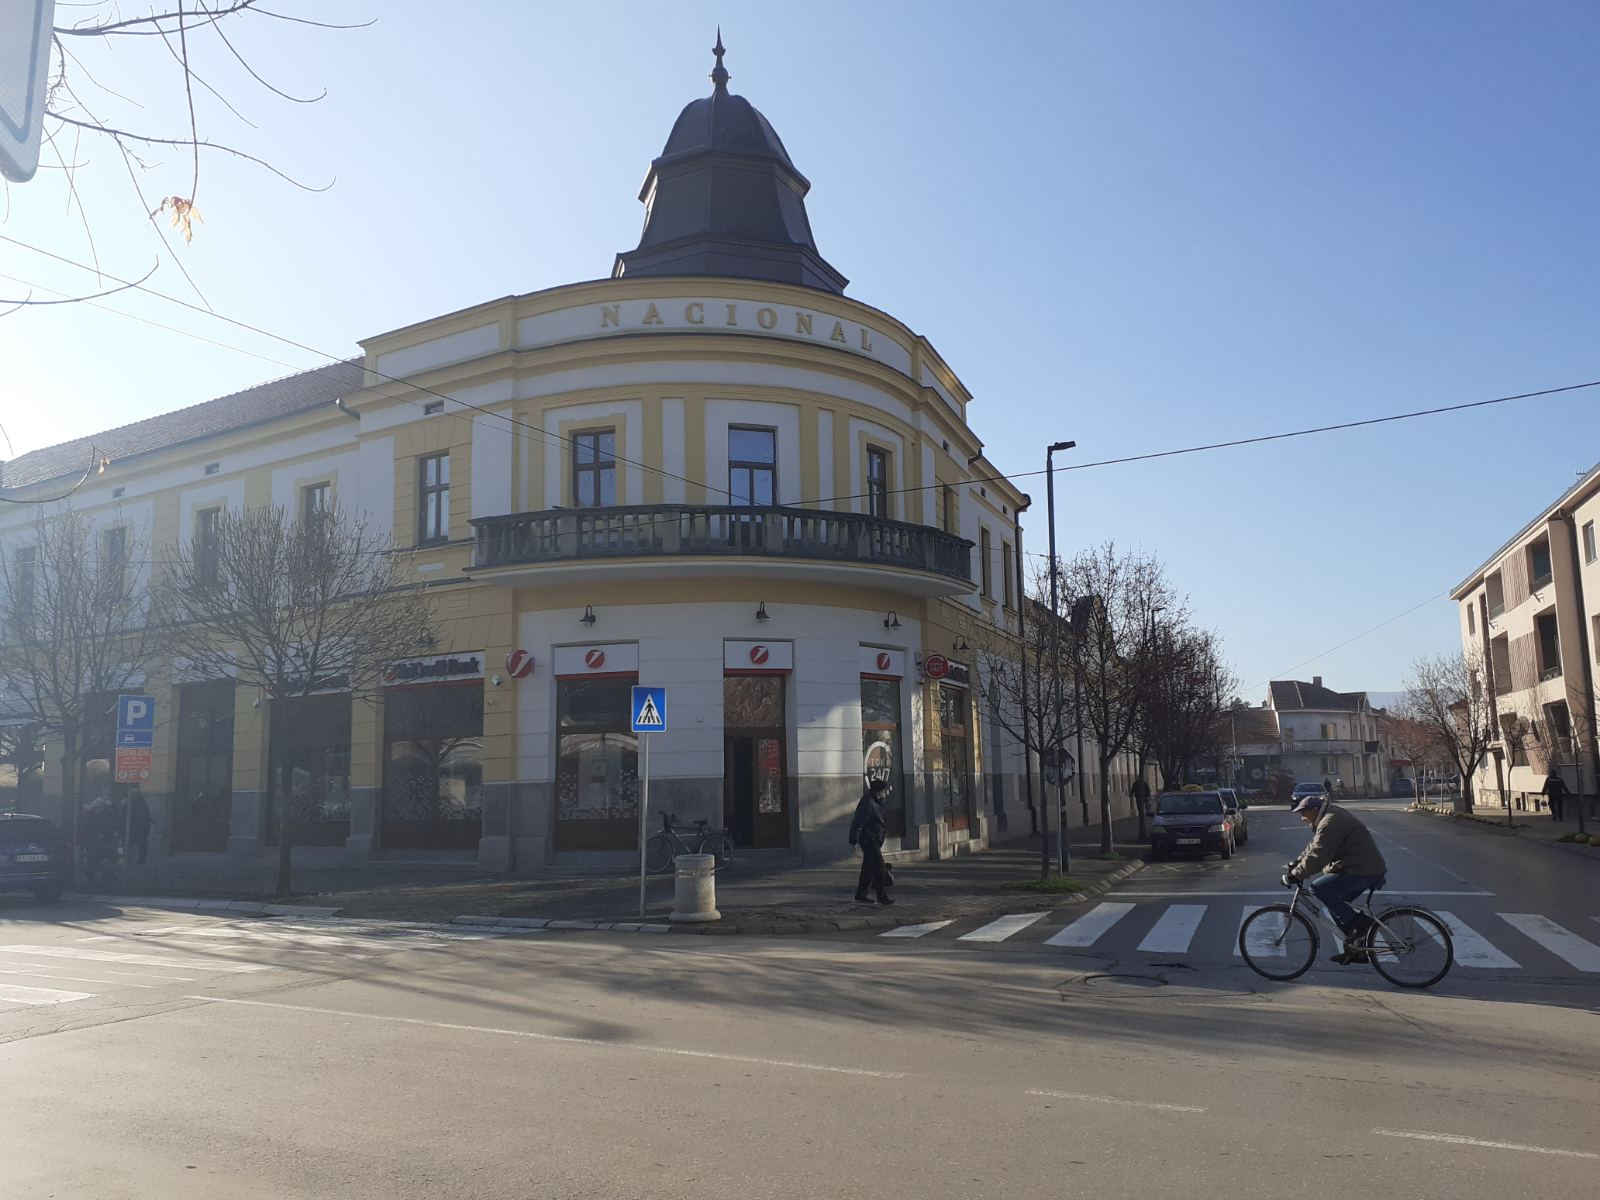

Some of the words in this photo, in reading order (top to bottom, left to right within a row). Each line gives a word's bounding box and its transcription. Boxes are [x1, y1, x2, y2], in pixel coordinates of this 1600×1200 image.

[601, 303, 873, 351] NACIONAL
[126, 700, 147, 725] P
[871, 767, 890, 782] 24/7
